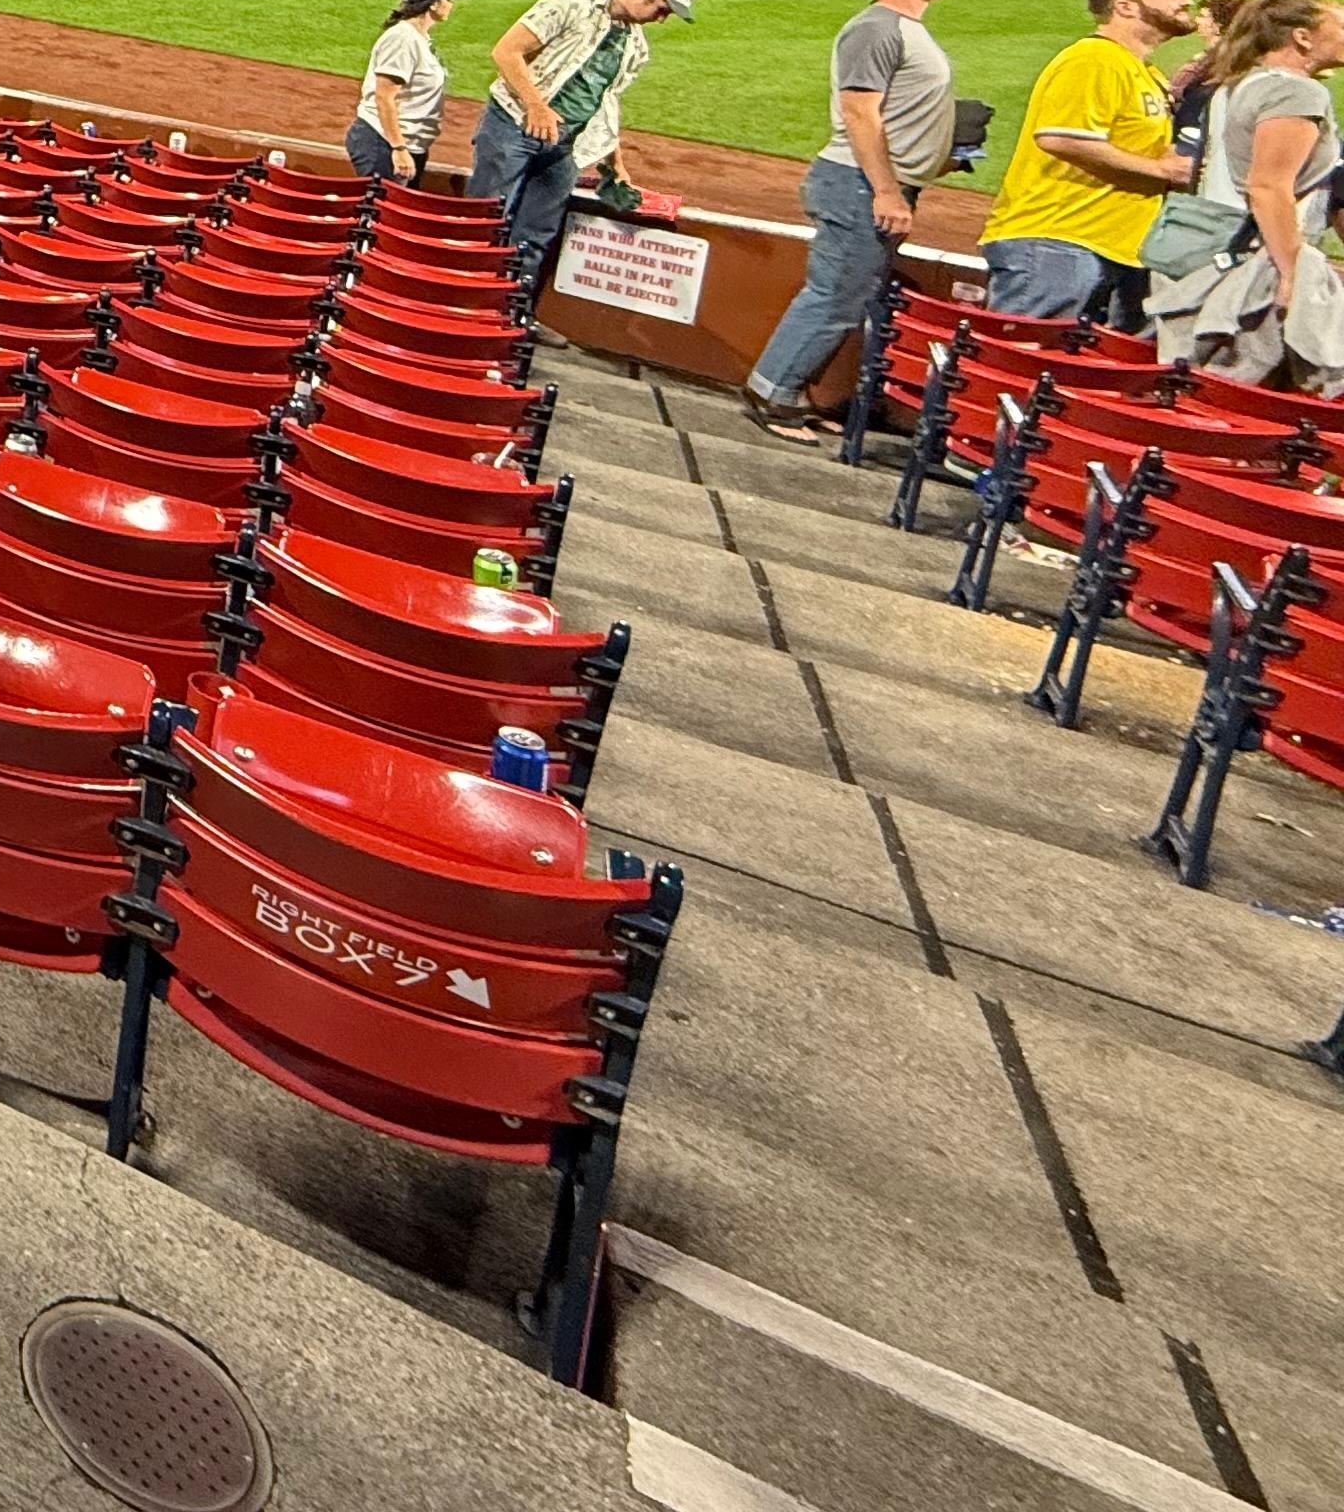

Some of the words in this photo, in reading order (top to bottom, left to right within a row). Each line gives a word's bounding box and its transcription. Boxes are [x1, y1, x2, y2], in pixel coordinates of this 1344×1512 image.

[570, 239, 586, 252] TO
[588, 243, 657, 269] INTERFERE
[661, 260, 694, 277] WITH
[573, 225, 604, 239] FANS
[608, 231, 635, 244] WHO
[638, 239, 697, 260] ATTEMPT
[573, 273, 602, 289] WILL
[607, 281, 622, 294] BE
[625, 284, 679, 308] EJECTED
[584, 259, 621, 277] BALLS
[625, 269, 638, 281] IN
[641, 272, 674, 289] PLAY
[251, 884, 343, 936] RIGHT
[348, 931, 439, 972] FIELD
[255, 900, 376, 975] BOX
[392, 962, 430, 986] 7
